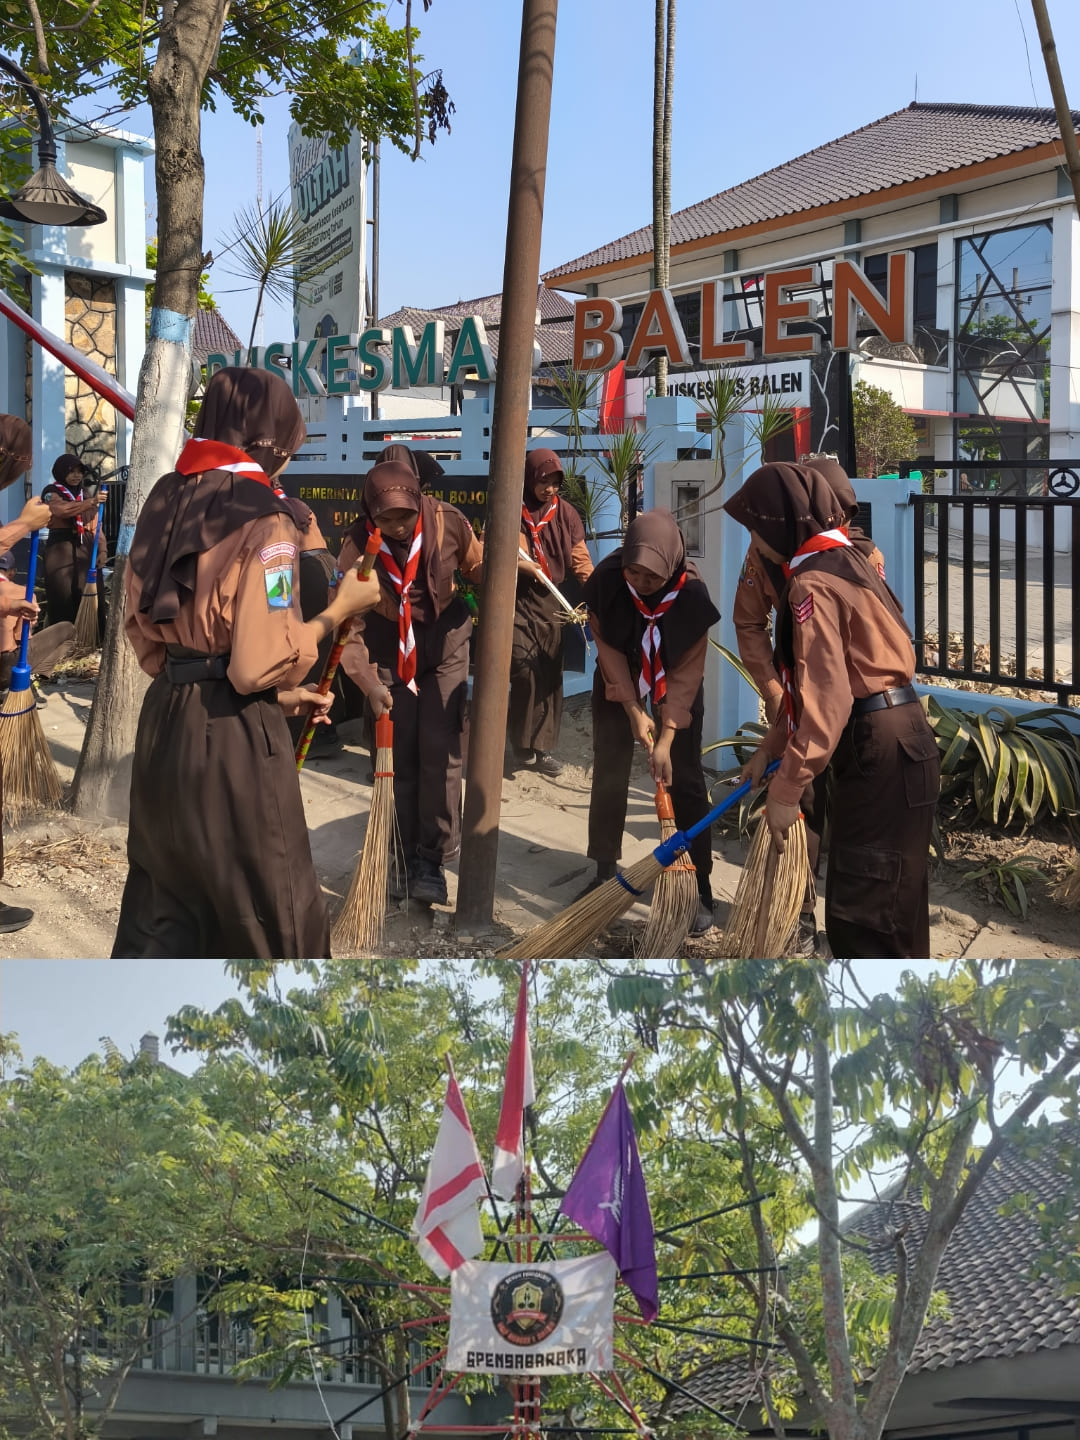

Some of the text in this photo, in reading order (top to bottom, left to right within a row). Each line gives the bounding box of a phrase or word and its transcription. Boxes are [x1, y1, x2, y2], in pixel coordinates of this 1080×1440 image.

[572, 250, 915, 373] BALEN
[750, 372, 803, 396] BALEN
[299, 486, 363, 501] PEMERINTA
